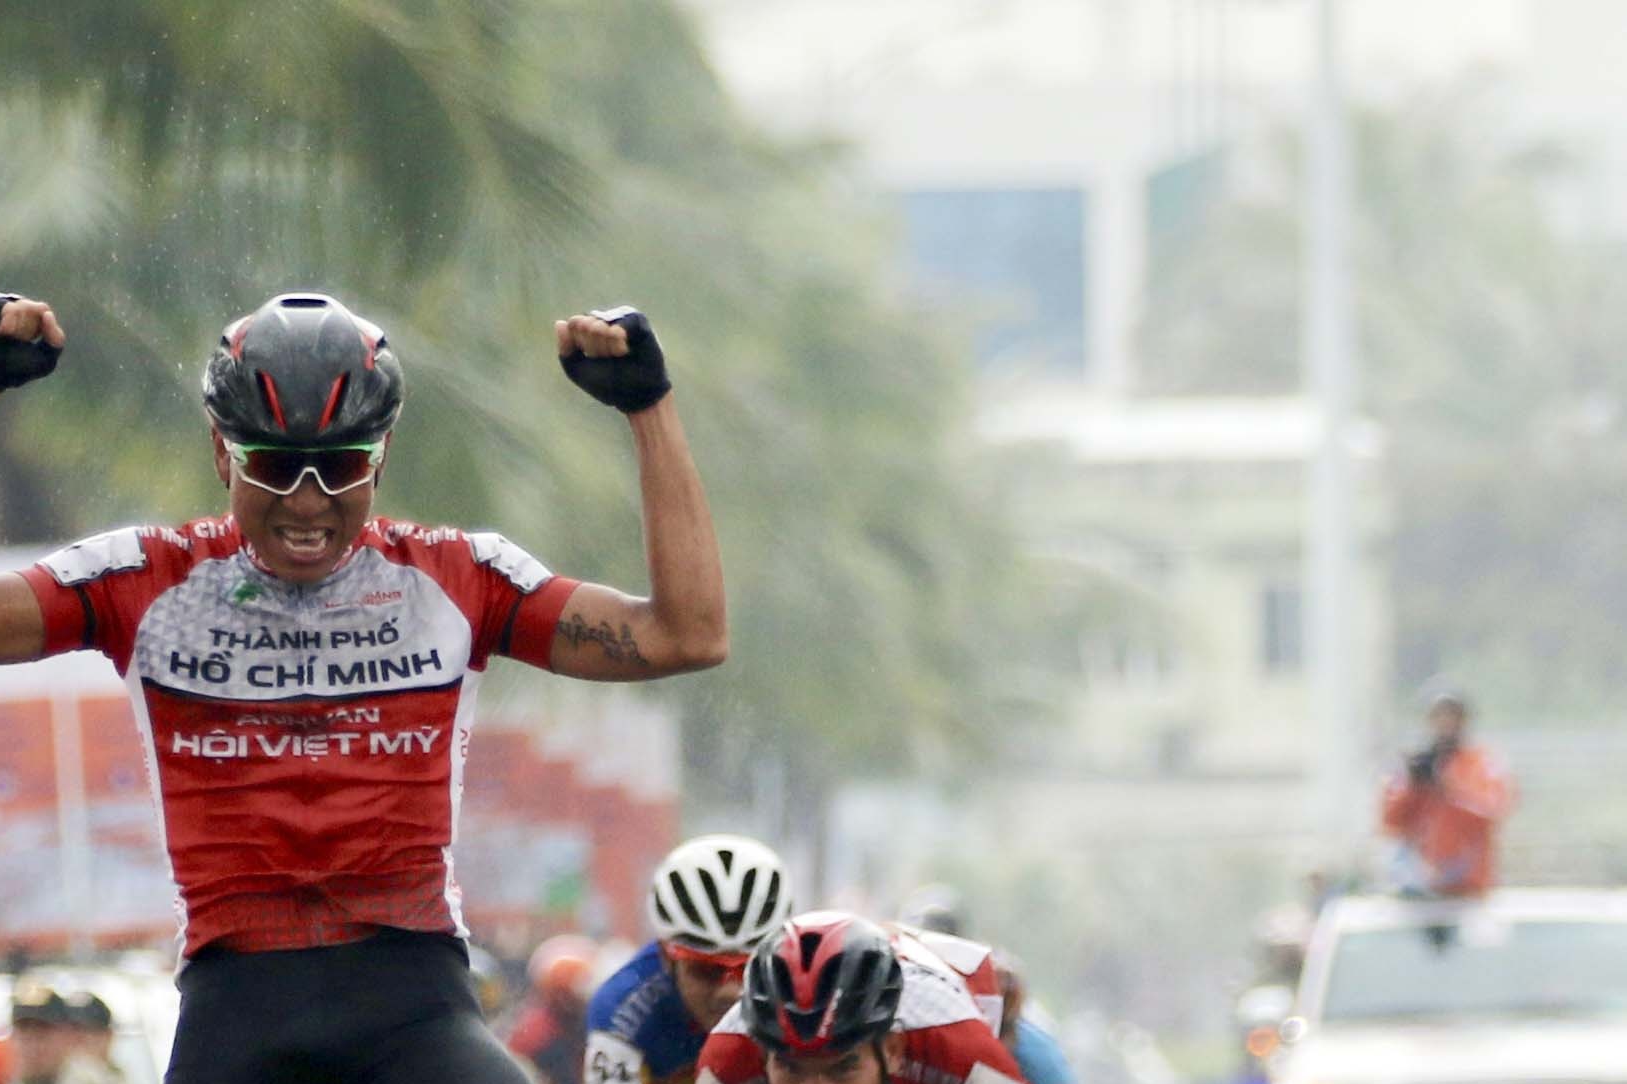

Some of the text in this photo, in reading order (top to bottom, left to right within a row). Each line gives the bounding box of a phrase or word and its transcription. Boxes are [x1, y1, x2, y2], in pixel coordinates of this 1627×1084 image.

[208, 616, 399, 651] THÀNH PHỐ
[169, 649, 442, 688] HỒ CHÍ MINH
[173, 728, 248, 765] HỘI
[256, 731, 362, 763] VIỆT
